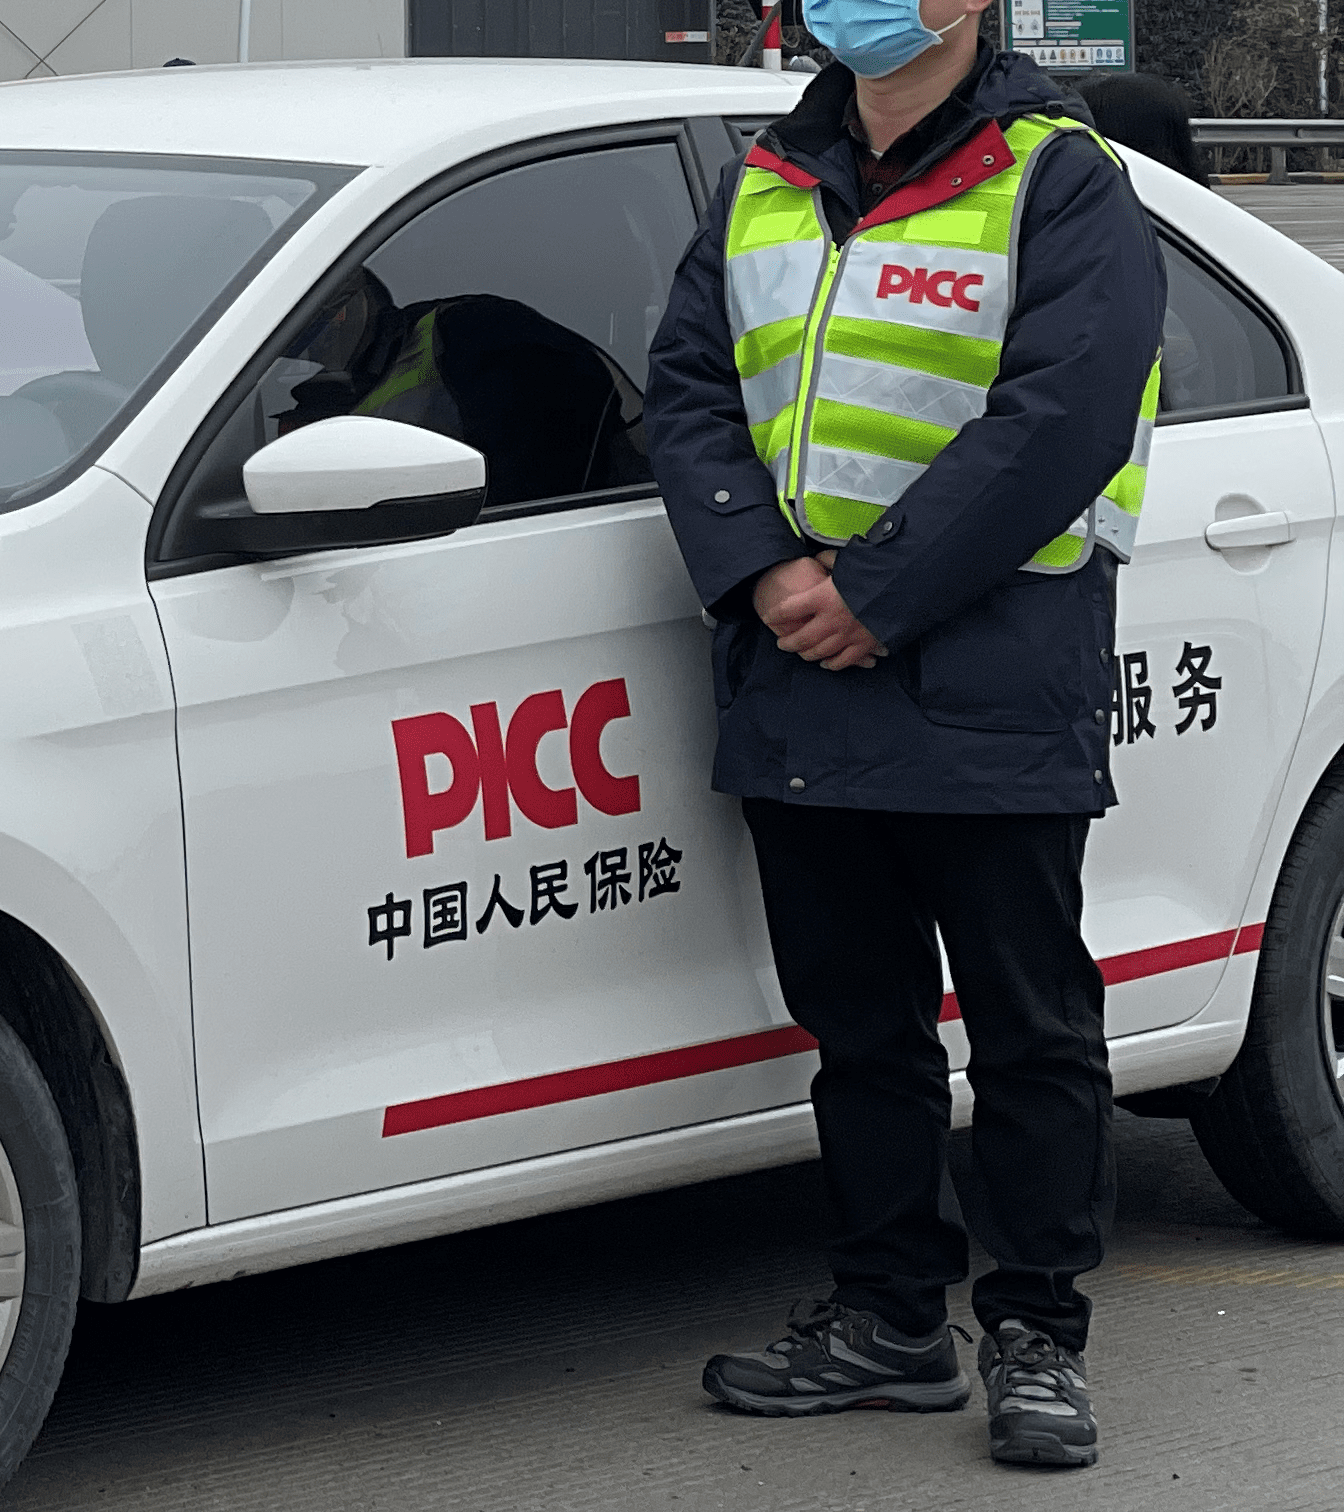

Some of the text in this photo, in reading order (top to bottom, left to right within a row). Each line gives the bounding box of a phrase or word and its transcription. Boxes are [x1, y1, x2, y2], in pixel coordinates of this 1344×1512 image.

[876, 263, 985, 313] PICC
[390, 677, 642, 860] PICC
[367, 836, 683, 961] 中国人民保险
